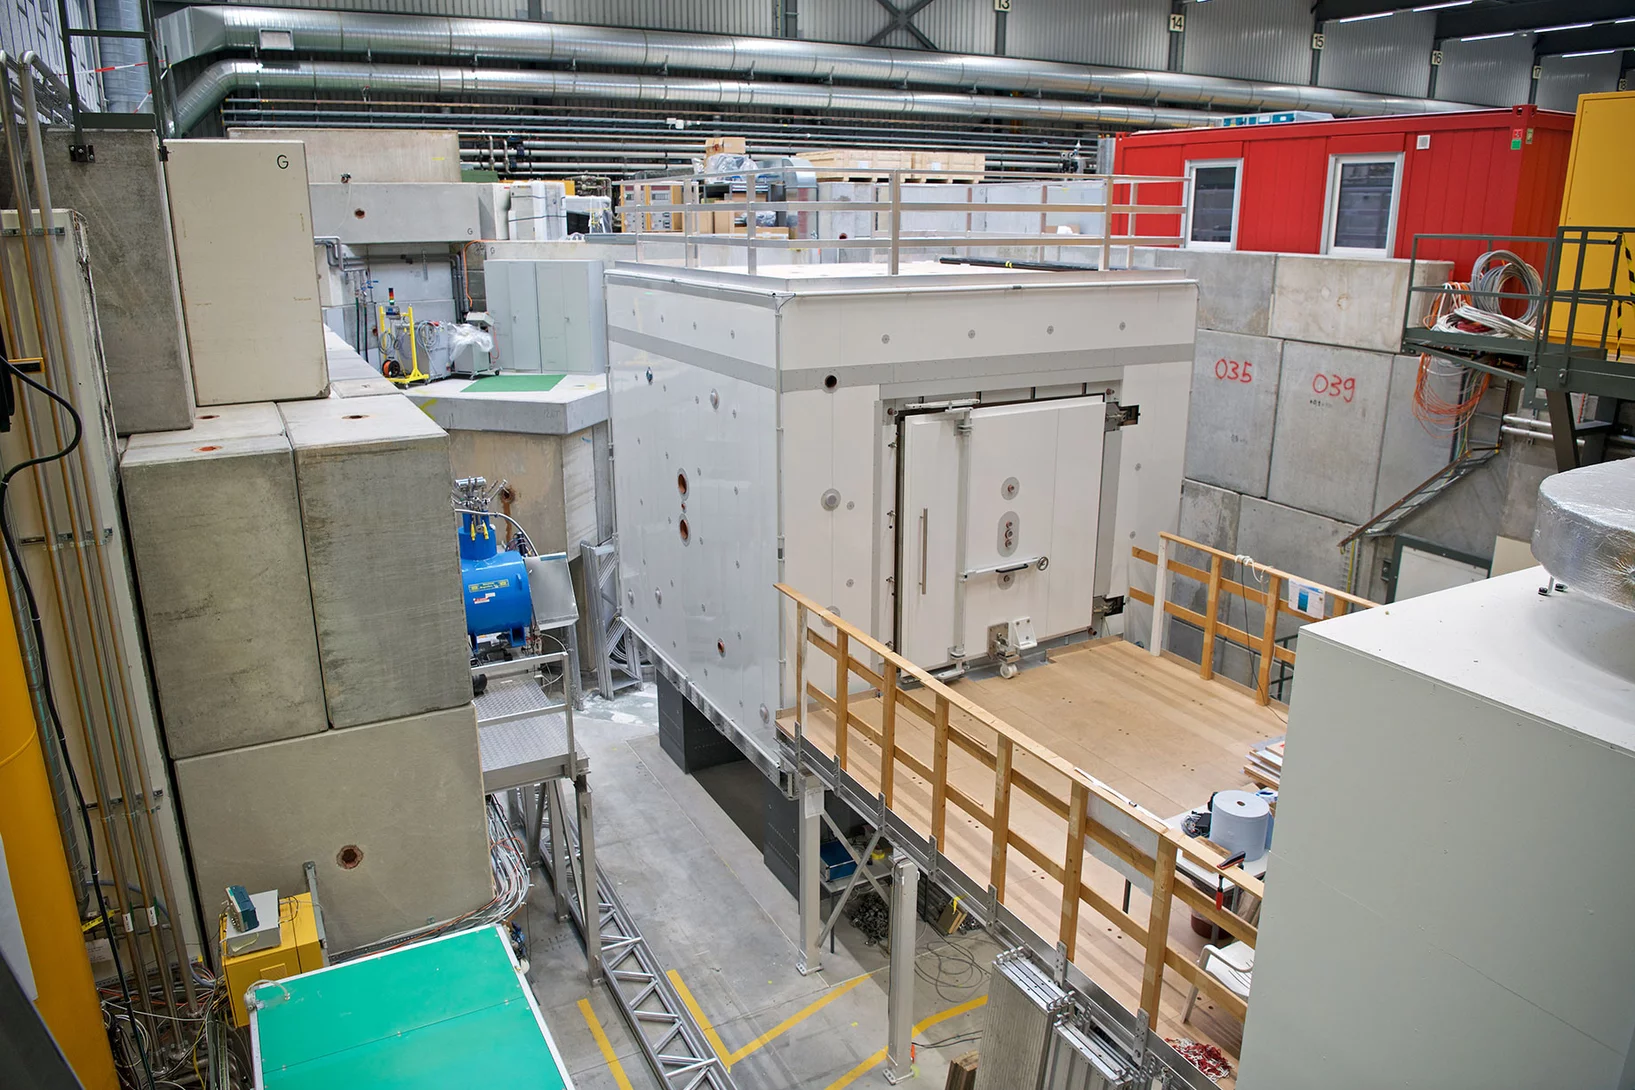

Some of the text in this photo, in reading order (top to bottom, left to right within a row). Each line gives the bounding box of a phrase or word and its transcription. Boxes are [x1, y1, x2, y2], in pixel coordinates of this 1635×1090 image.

[997, 0, 1010, 9] 13
[1172, 16, 1182, 29] 14
[1314, 35, 1324, 48] 15
[1433, 52, 1442, 64] 16
[1534, 66, 1542, 77] 17
[277, 154, 289, 170] G
[467, 227, 474, 236] G
[1215, 358, 1253, 383] 035
[1312, 373, 1356, 403] 039
